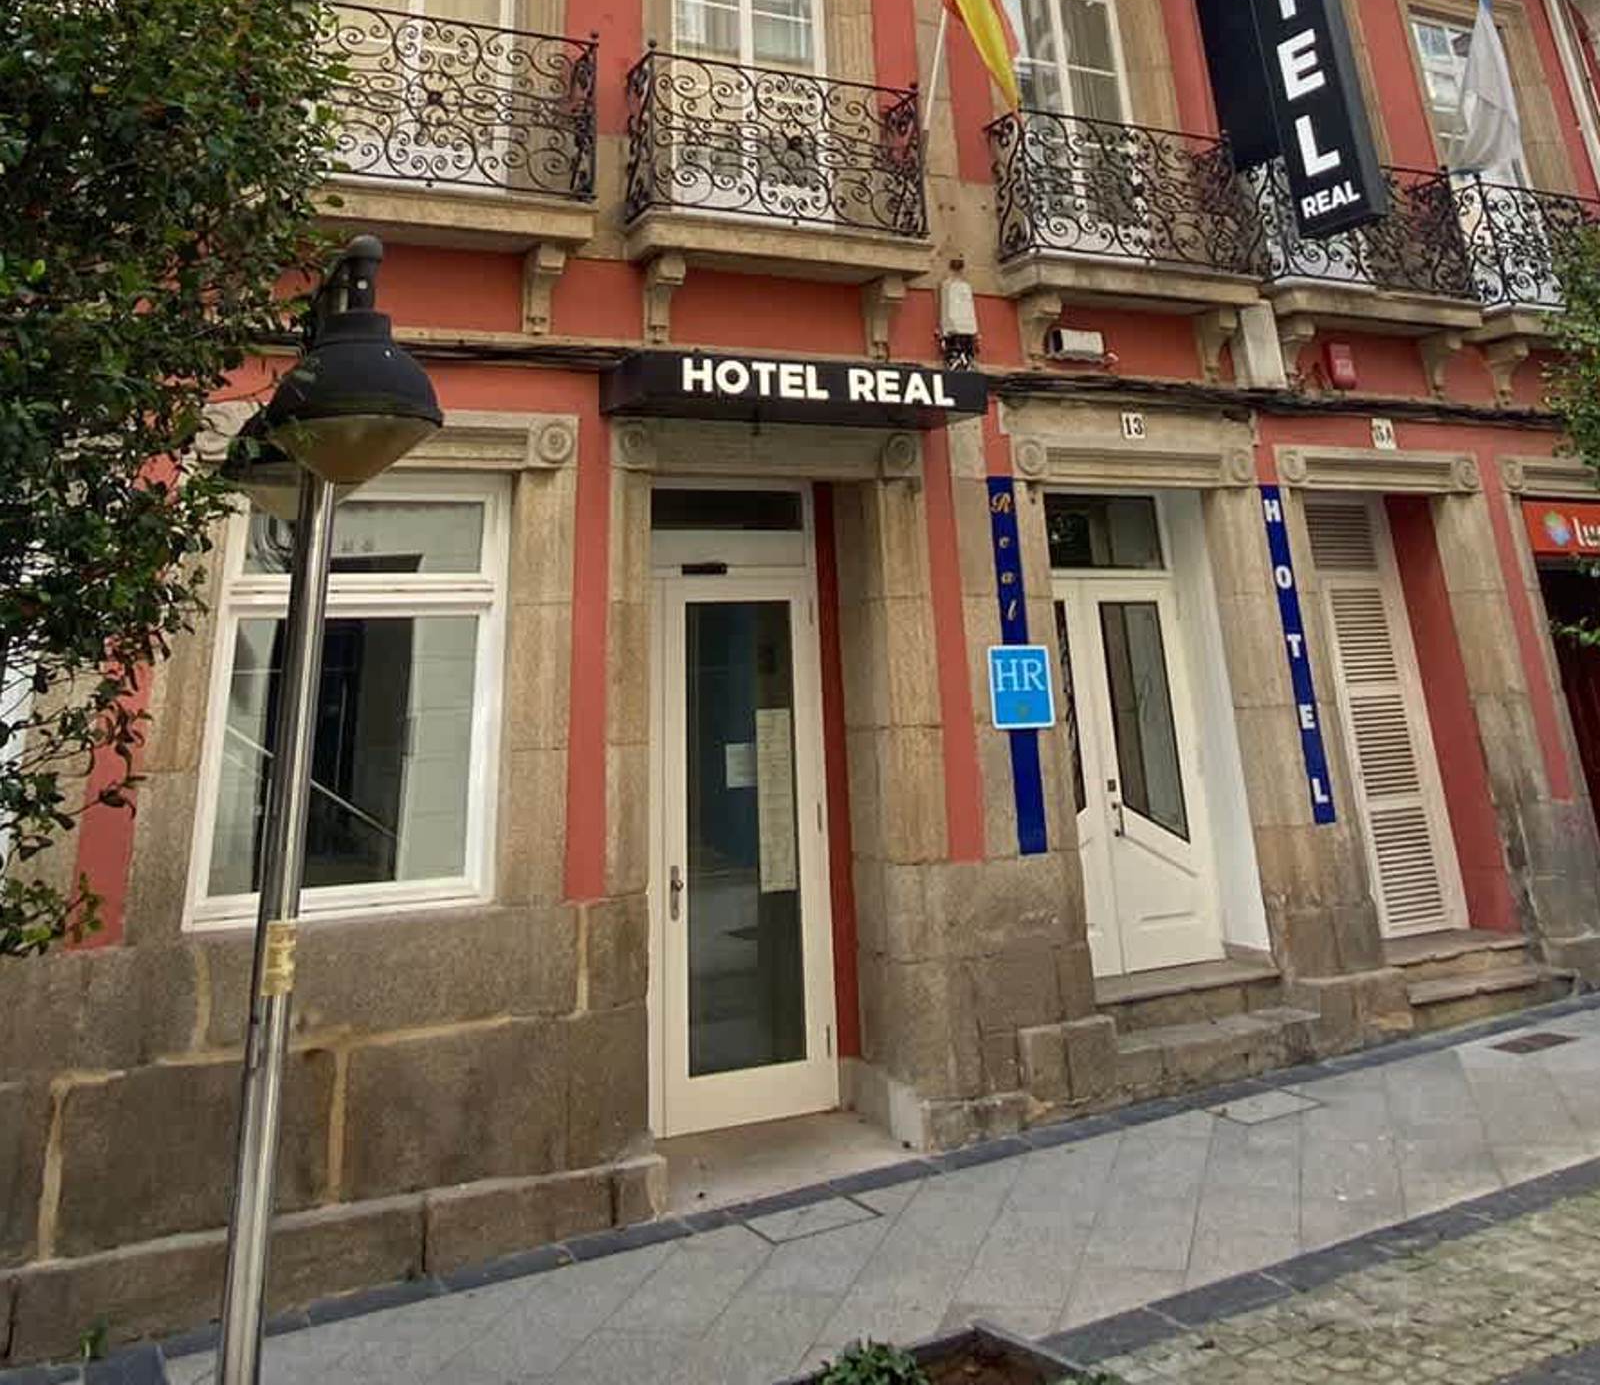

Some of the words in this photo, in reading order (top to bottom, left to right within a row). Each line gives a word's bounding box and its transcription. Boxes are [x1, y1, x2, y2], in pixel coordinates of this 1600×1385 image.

[1301, 180, 1361, 217] REAL
[681, 357, 829, 400] HOTEL
[848, 368, 956, 407] REAL
[1124, 416, 1144, 436] 13
[1263, 499, 1329, 804] HOTEL
[995, 658, 1046, 692] HR
